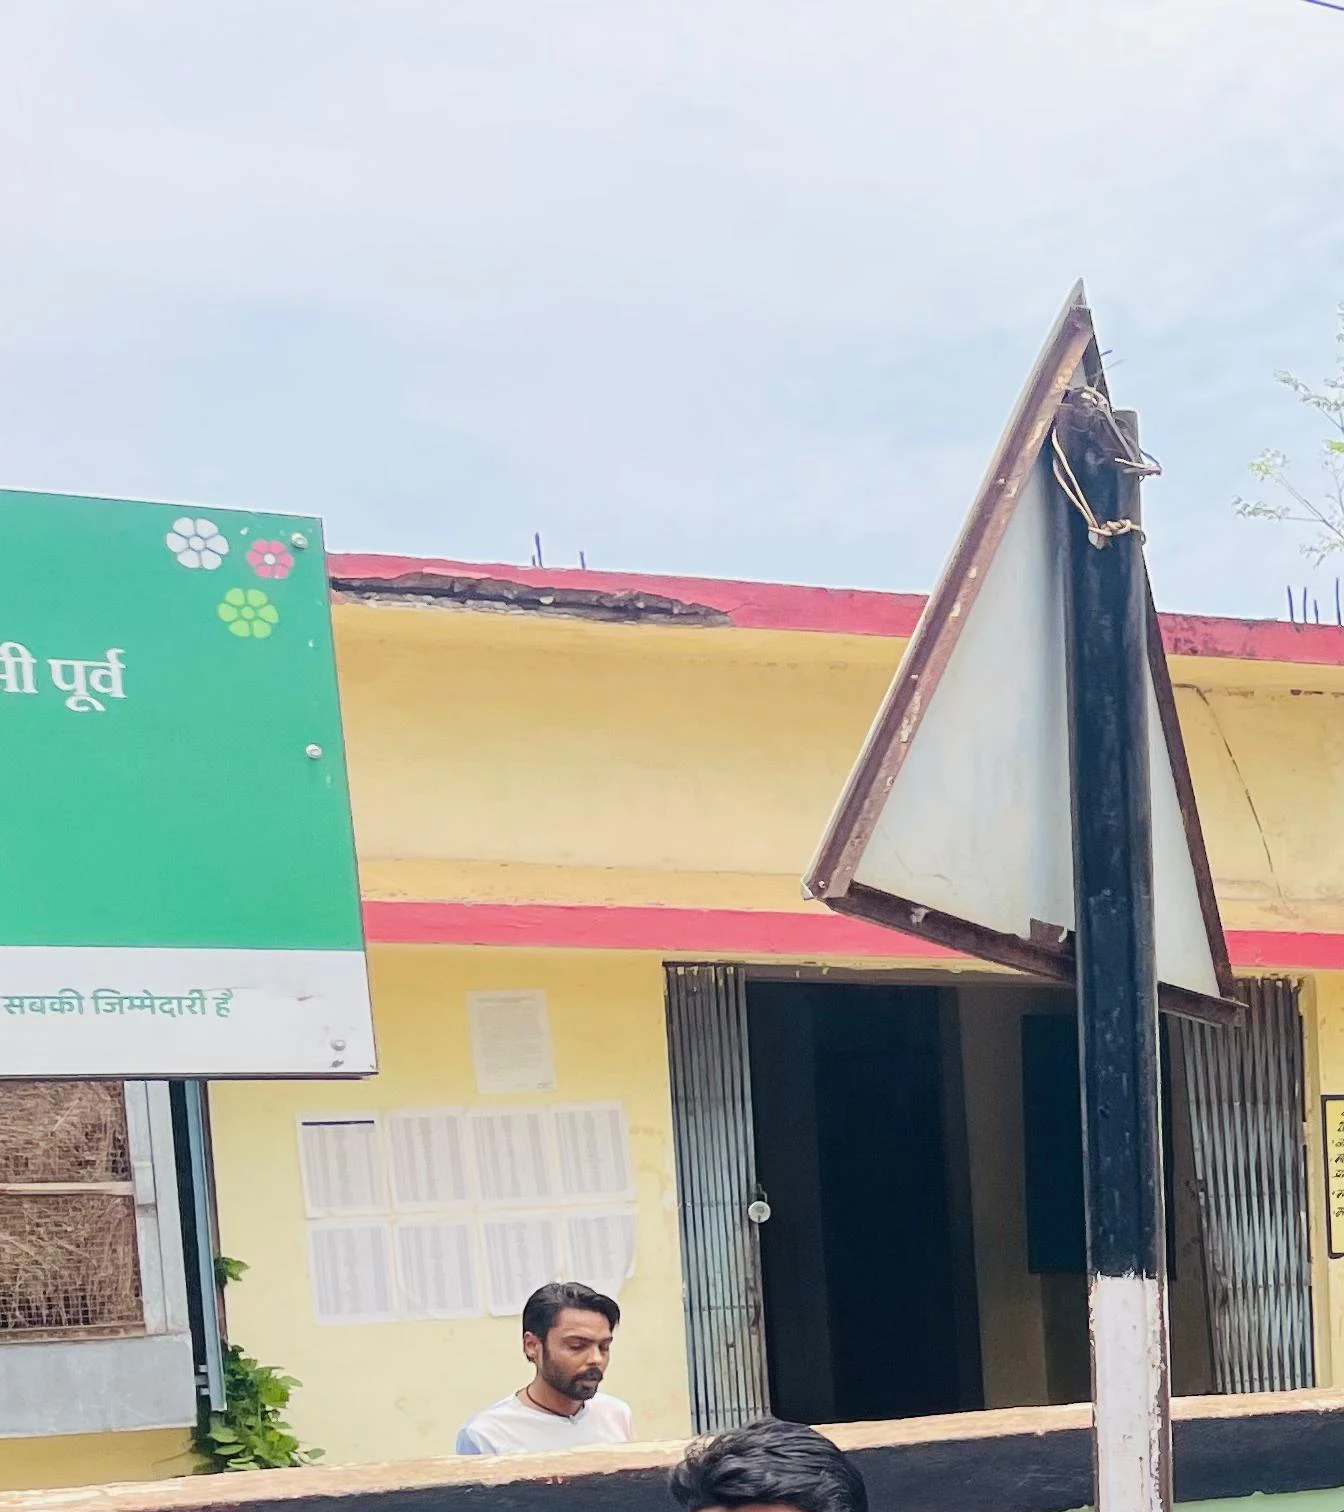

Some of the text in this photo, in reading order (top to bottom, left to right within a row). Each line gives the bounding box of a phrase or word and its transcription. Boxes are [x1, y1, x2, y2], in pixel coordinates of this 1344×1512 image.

[46, 647, 128, 712] पूर्व
[0, 988, 234, 1018] सबकी जिम्मेदारी है
